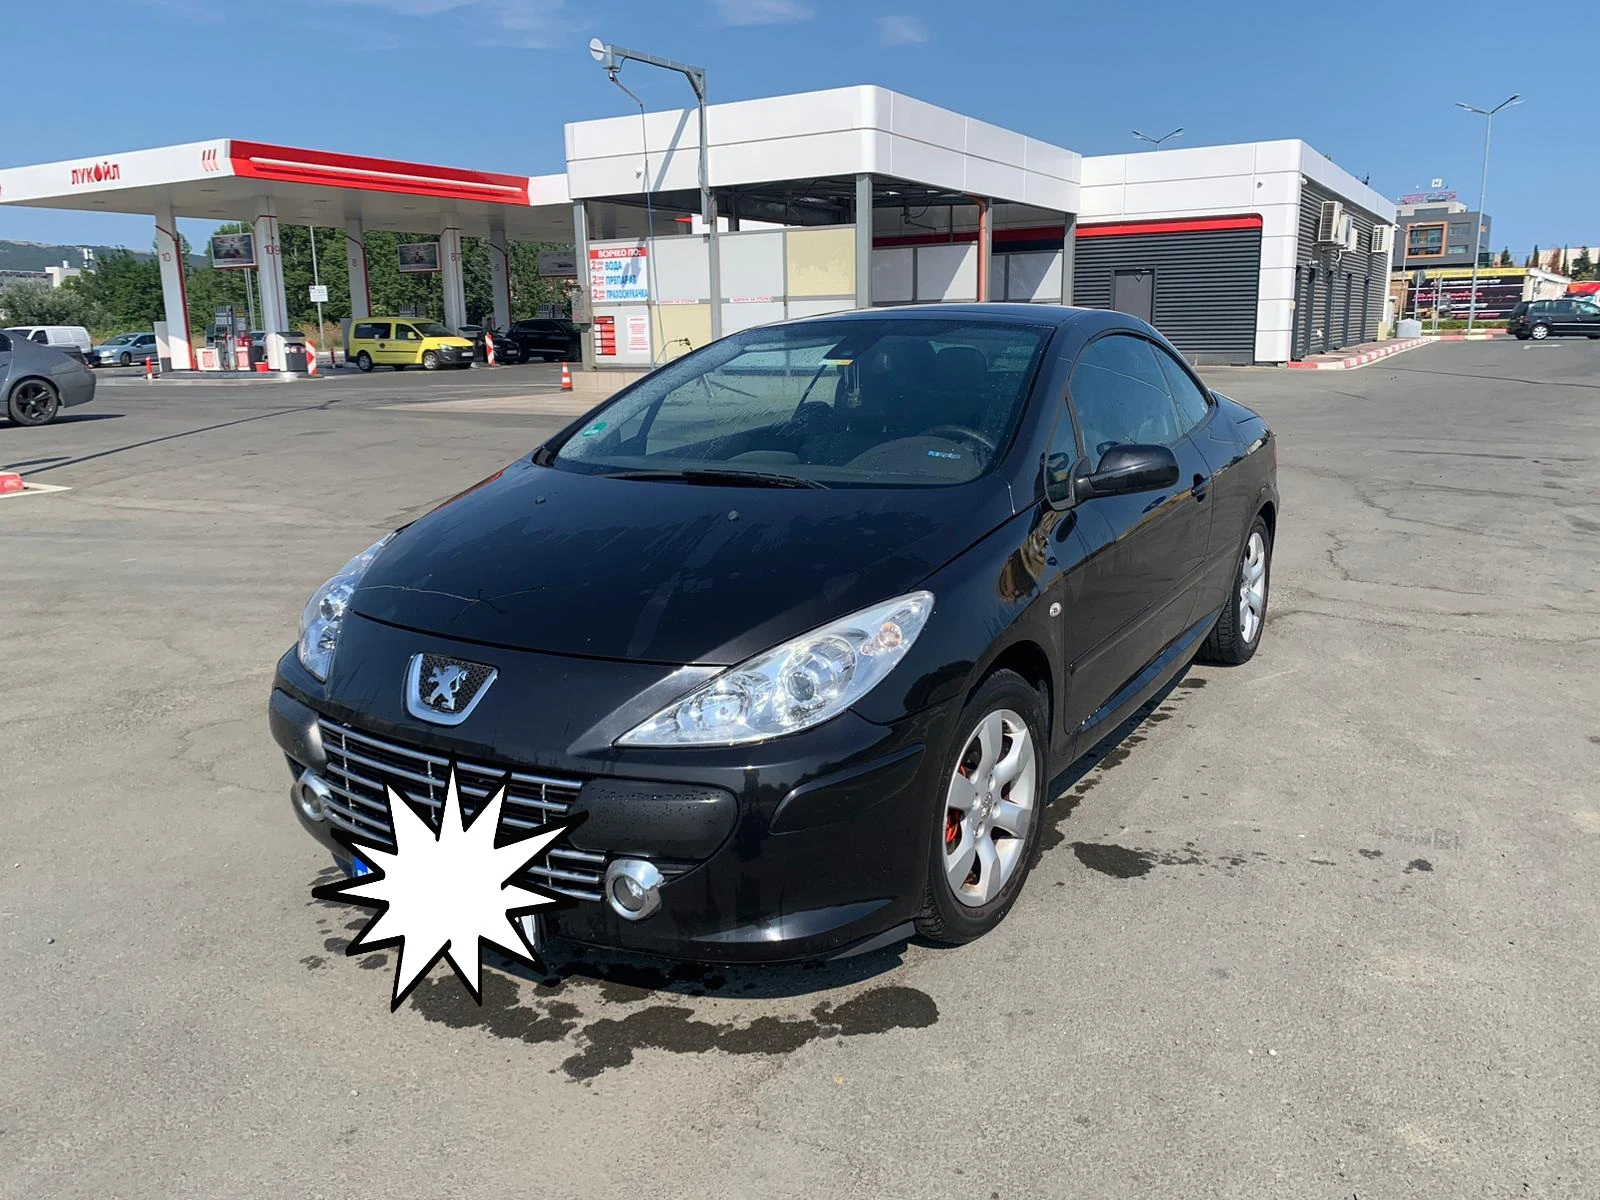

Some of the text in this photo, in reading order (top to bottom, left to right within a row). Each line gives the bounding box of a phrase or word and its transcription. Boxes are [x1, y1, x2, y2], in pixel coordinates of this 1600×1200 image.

[71, 161, 120, 185] ЛУКОЙЛ
[591, 260, 597, 270] 2
[605, 261, 622, 271] ВОДА
[592, 275, 598, 285] 2
[606, 275, 637, 285] ПРЕПАРАТ
[593, 289, 599, 299] 2
